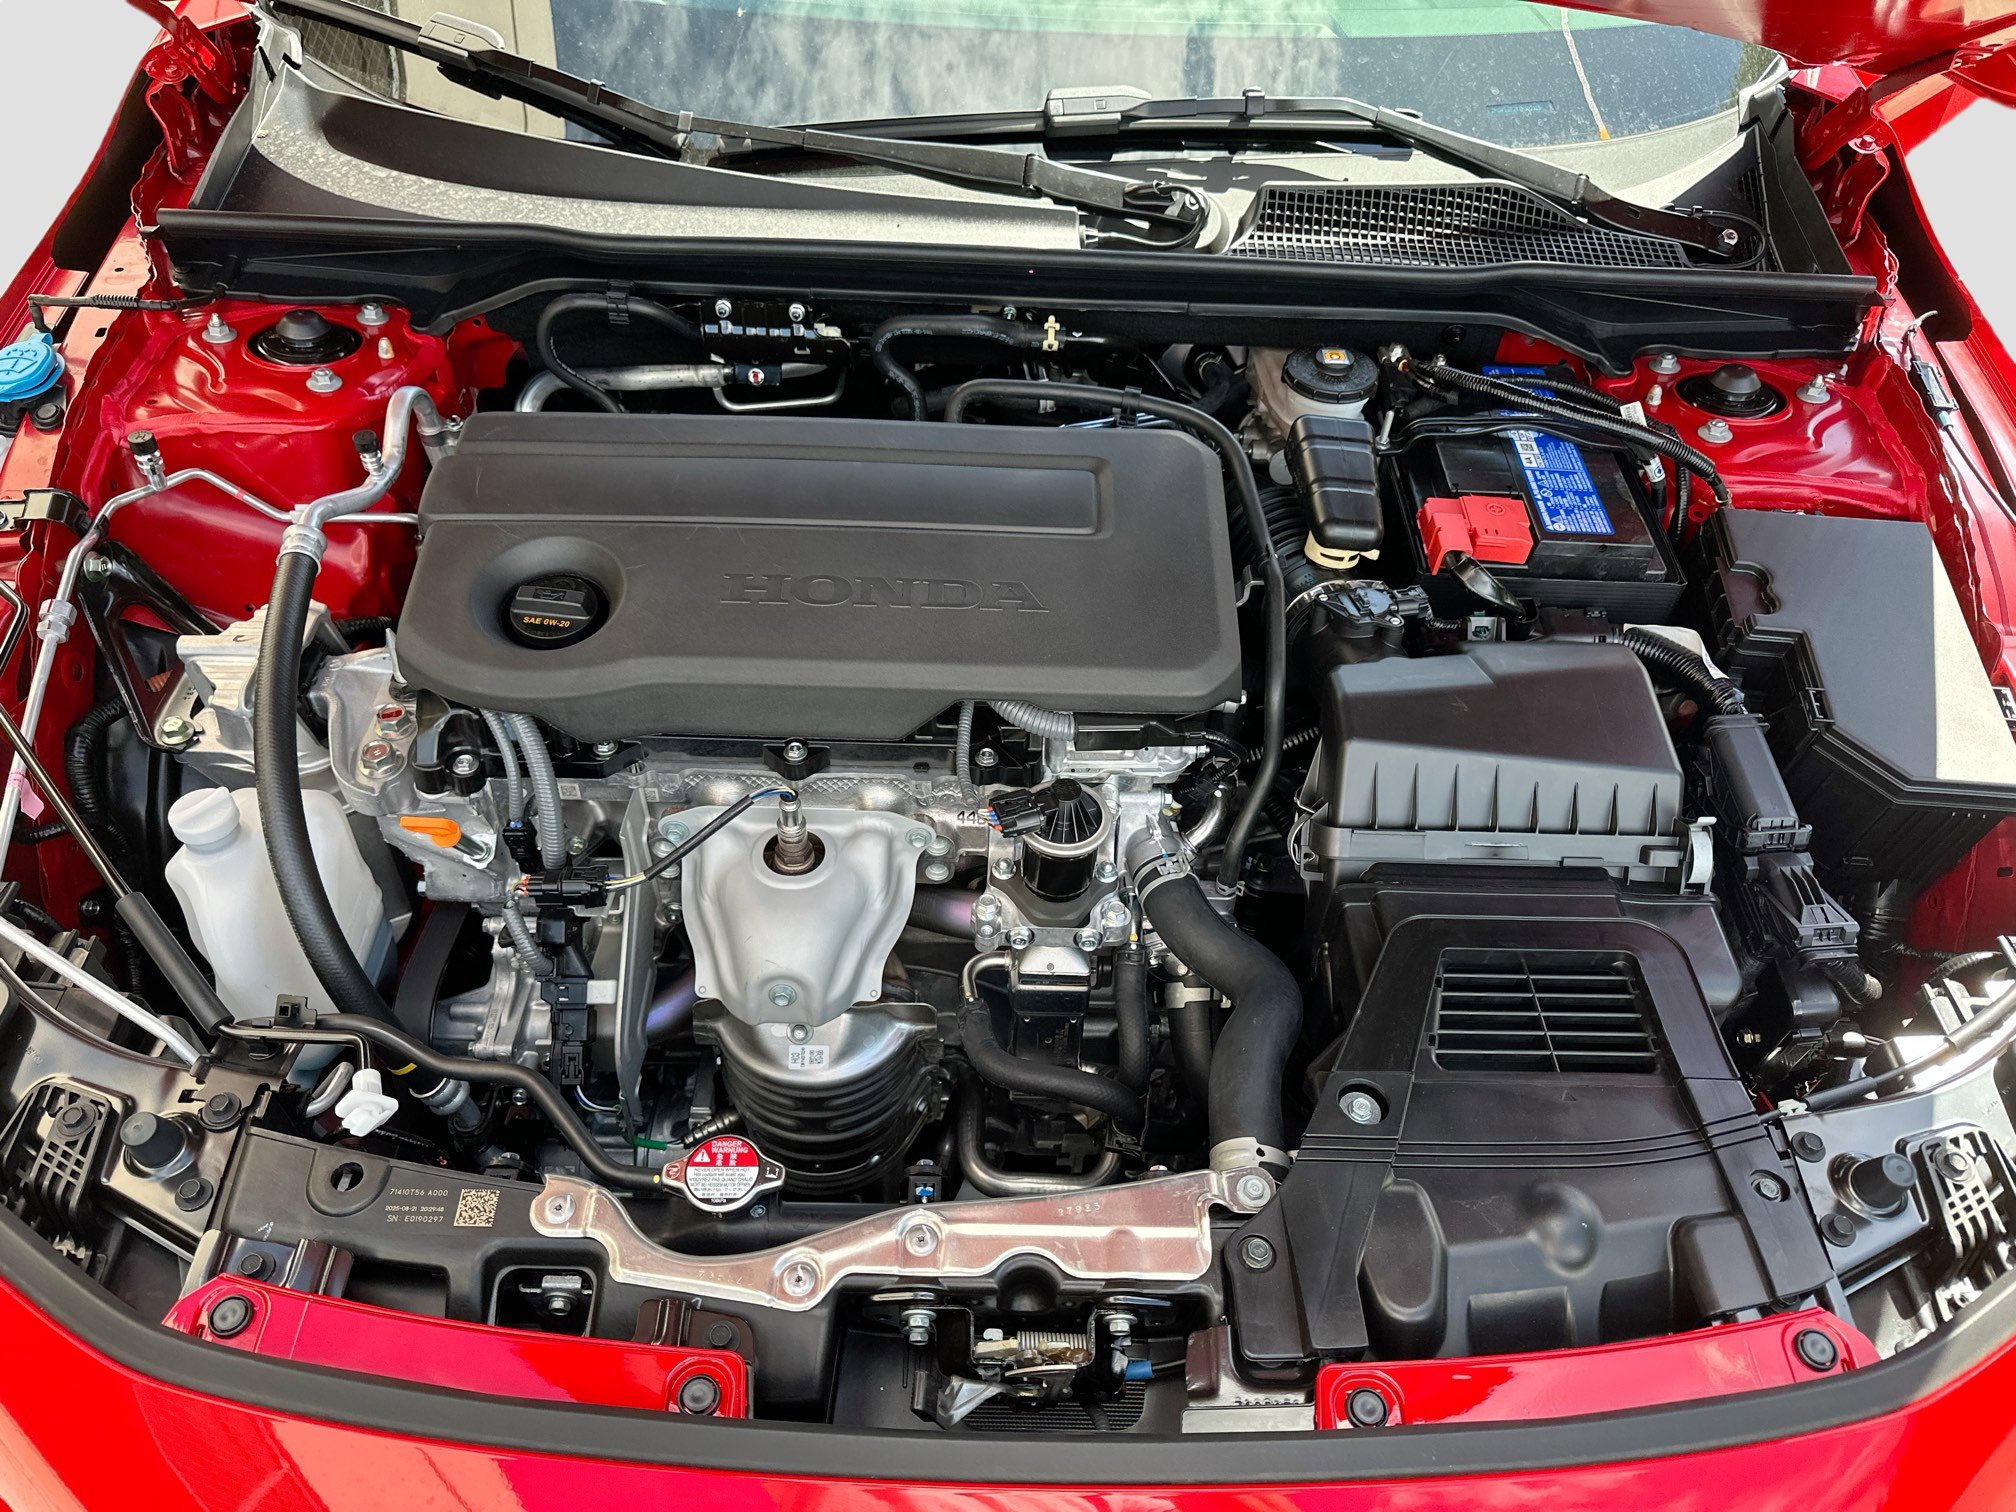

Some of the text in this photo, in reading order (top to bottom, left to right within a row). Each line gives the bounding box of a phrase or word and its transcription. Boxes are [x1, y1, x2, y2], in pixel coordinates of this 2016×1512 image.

[720, 573, 1050, 613] HONDA
[523, 616, 571, 628] SAE 0W-20
[711, 1146, 749, 1154] WARNUNG
[389, 1188, 449, 1197] 71410T56 A000
[404, 1215, 444, 1223] E0190297
